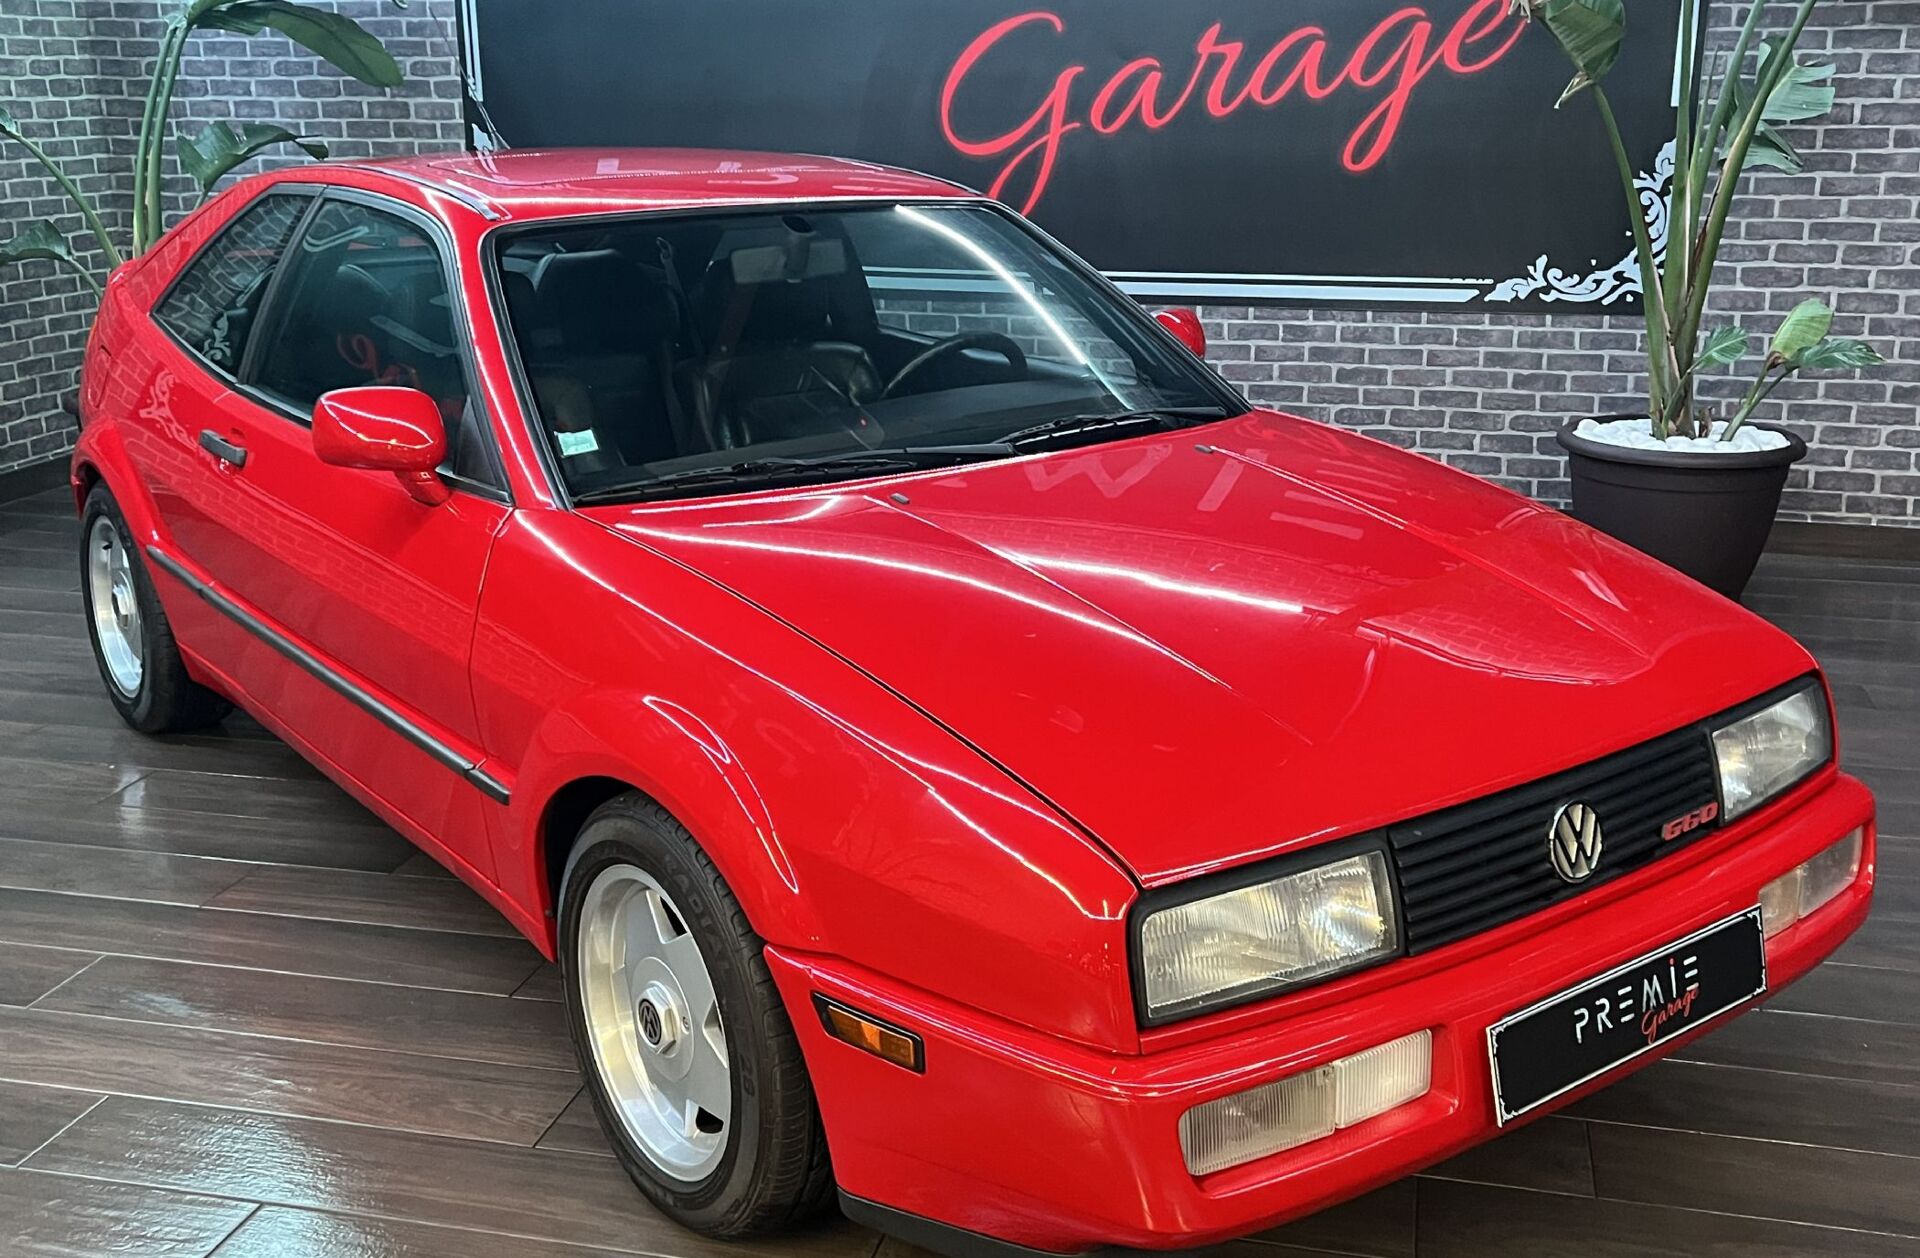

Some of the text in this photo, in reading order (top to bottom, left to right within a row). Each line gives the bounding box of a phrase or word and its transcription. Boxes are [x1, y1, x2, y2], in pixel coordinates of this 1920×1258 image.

[941, 0, 1527, 217] Garage
[1549, 800, 1603, 883] VW
[1661, 801, 1719, 841] G60
[1574, 956, 1699, 1044] PREMIE
[1641, 987, 1698, 1045] Garage
